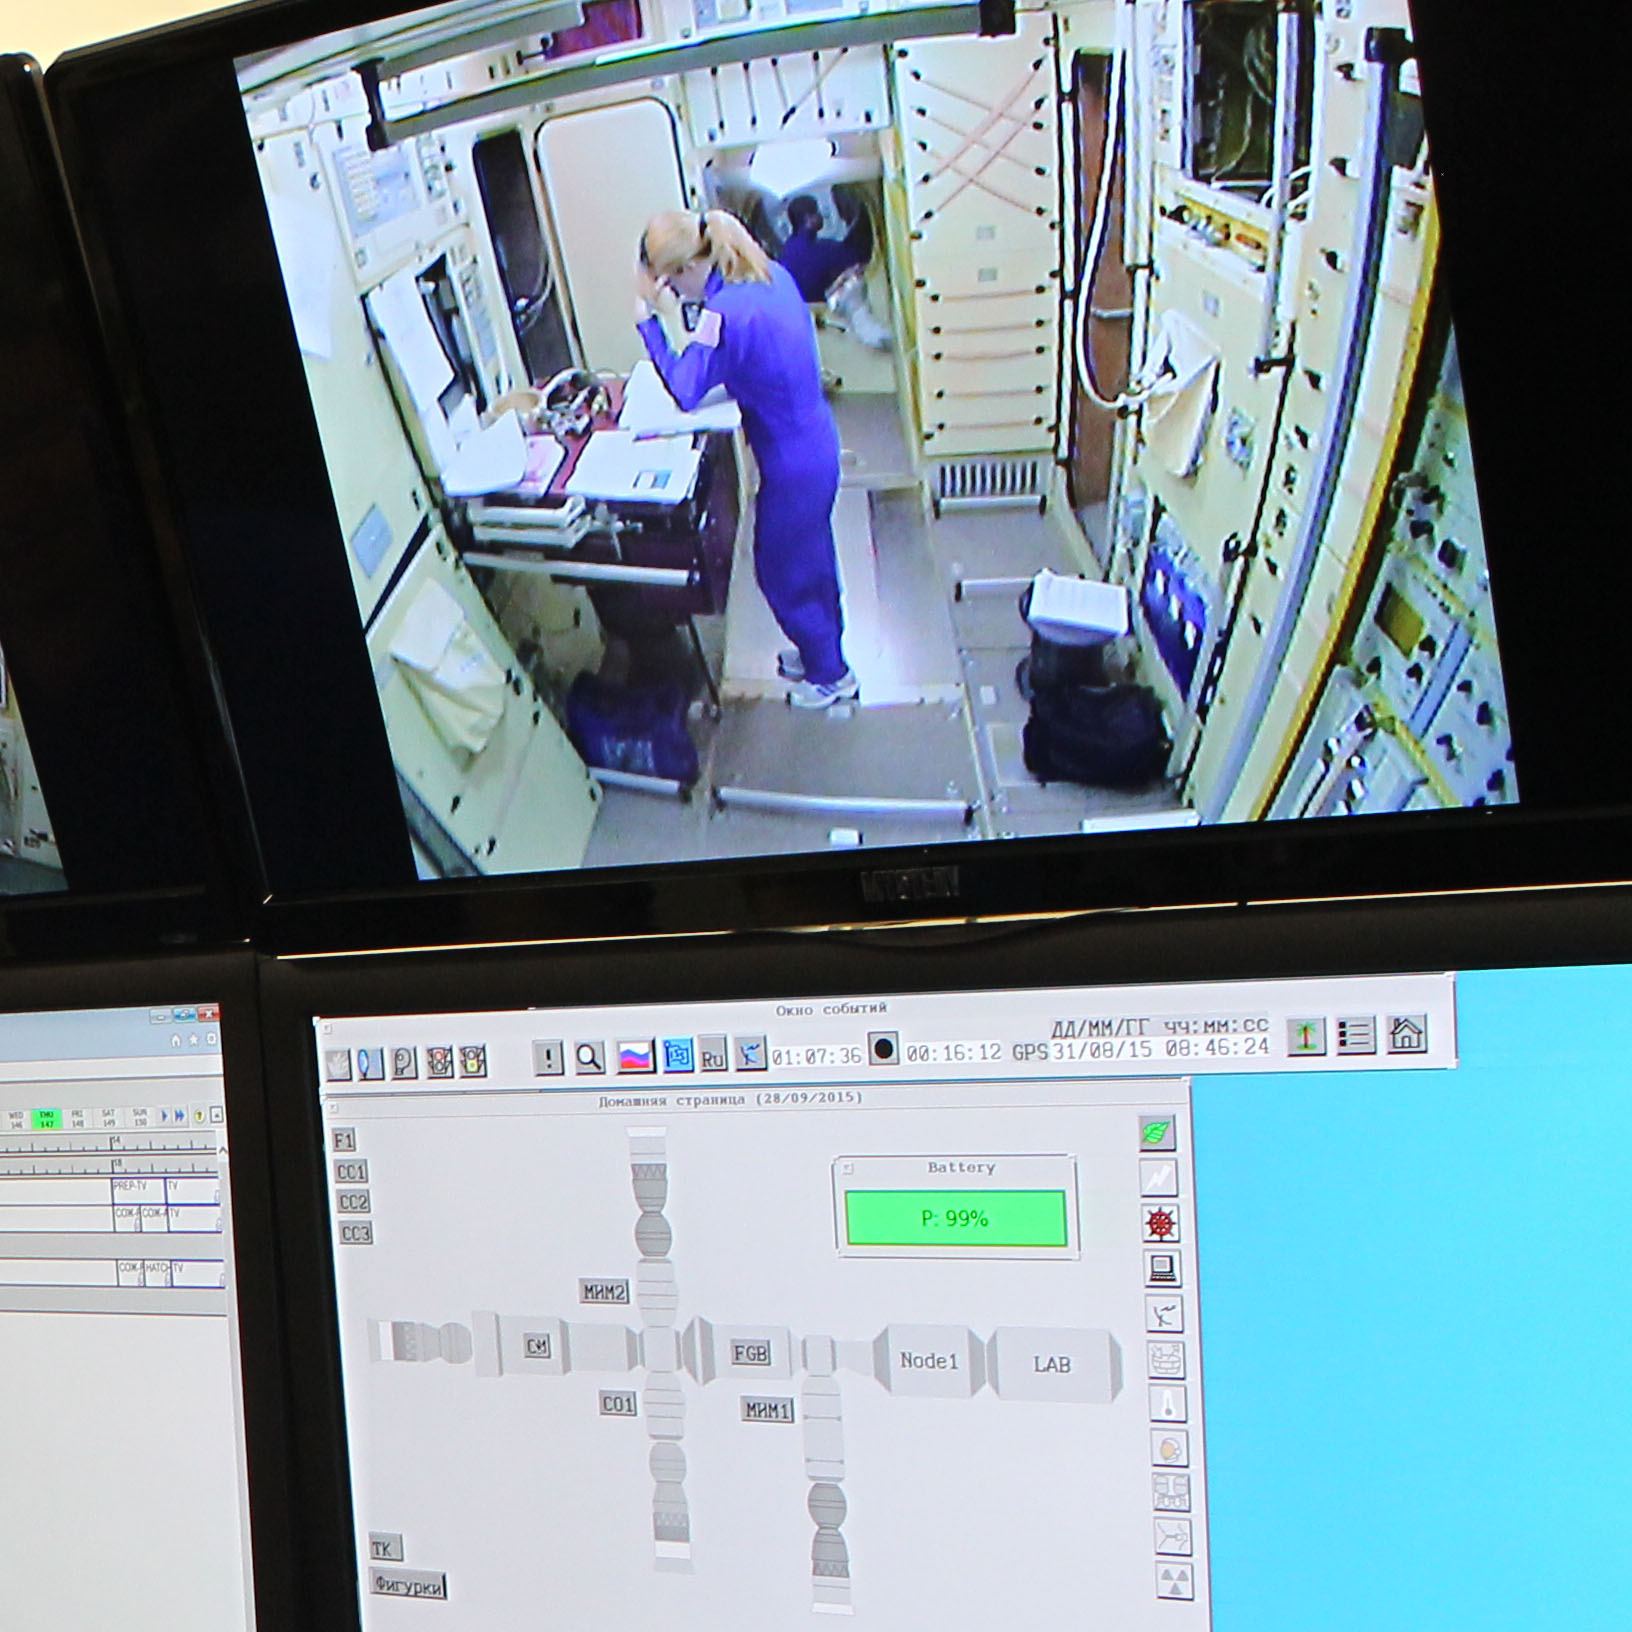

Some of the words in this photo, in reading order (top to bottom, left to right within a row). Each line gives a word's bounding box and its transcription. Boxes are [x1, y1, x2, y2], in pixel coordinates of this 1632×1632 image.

[776, 1003, 814, 1017] Окно
[822, 1001, 888, 1016] событий
[1050, 1017, 1150, 1040] ДД/ММ/ГГ
[701, 1049, 725, 1070] Ru
[772, 1046, 863, 1067] 01:07:36
[906, 1040, 1003, 1064] 00:16:12
[1012, 1042, 1049, 1063] GPS
[1053, 1039, 1152, 1062] 31/08/15
[1165, 1035, 1270, 1060] 08:46:24
[598, 1094, 669, 1109] Домашняя
[676, 1093, 746, 1108] страница
[755, 1090, 864, 1107] (28/09/2015)
[927, 1160, 996, 1177] Battery
[921, 1209, 939, 1228] P:
[944, 1206, 989, 1229] 99%
[583, 1283, 627, 1301] МИМ2
[734, 1344, 768, 1362] FGB
[900, 1349, 959, 1371] Node1
[1034, 1355, 1071, 1376] LAB
[746, 1402, 791, 1420] МИМ1
[376, 1576, 442, 1598] Фигурки
